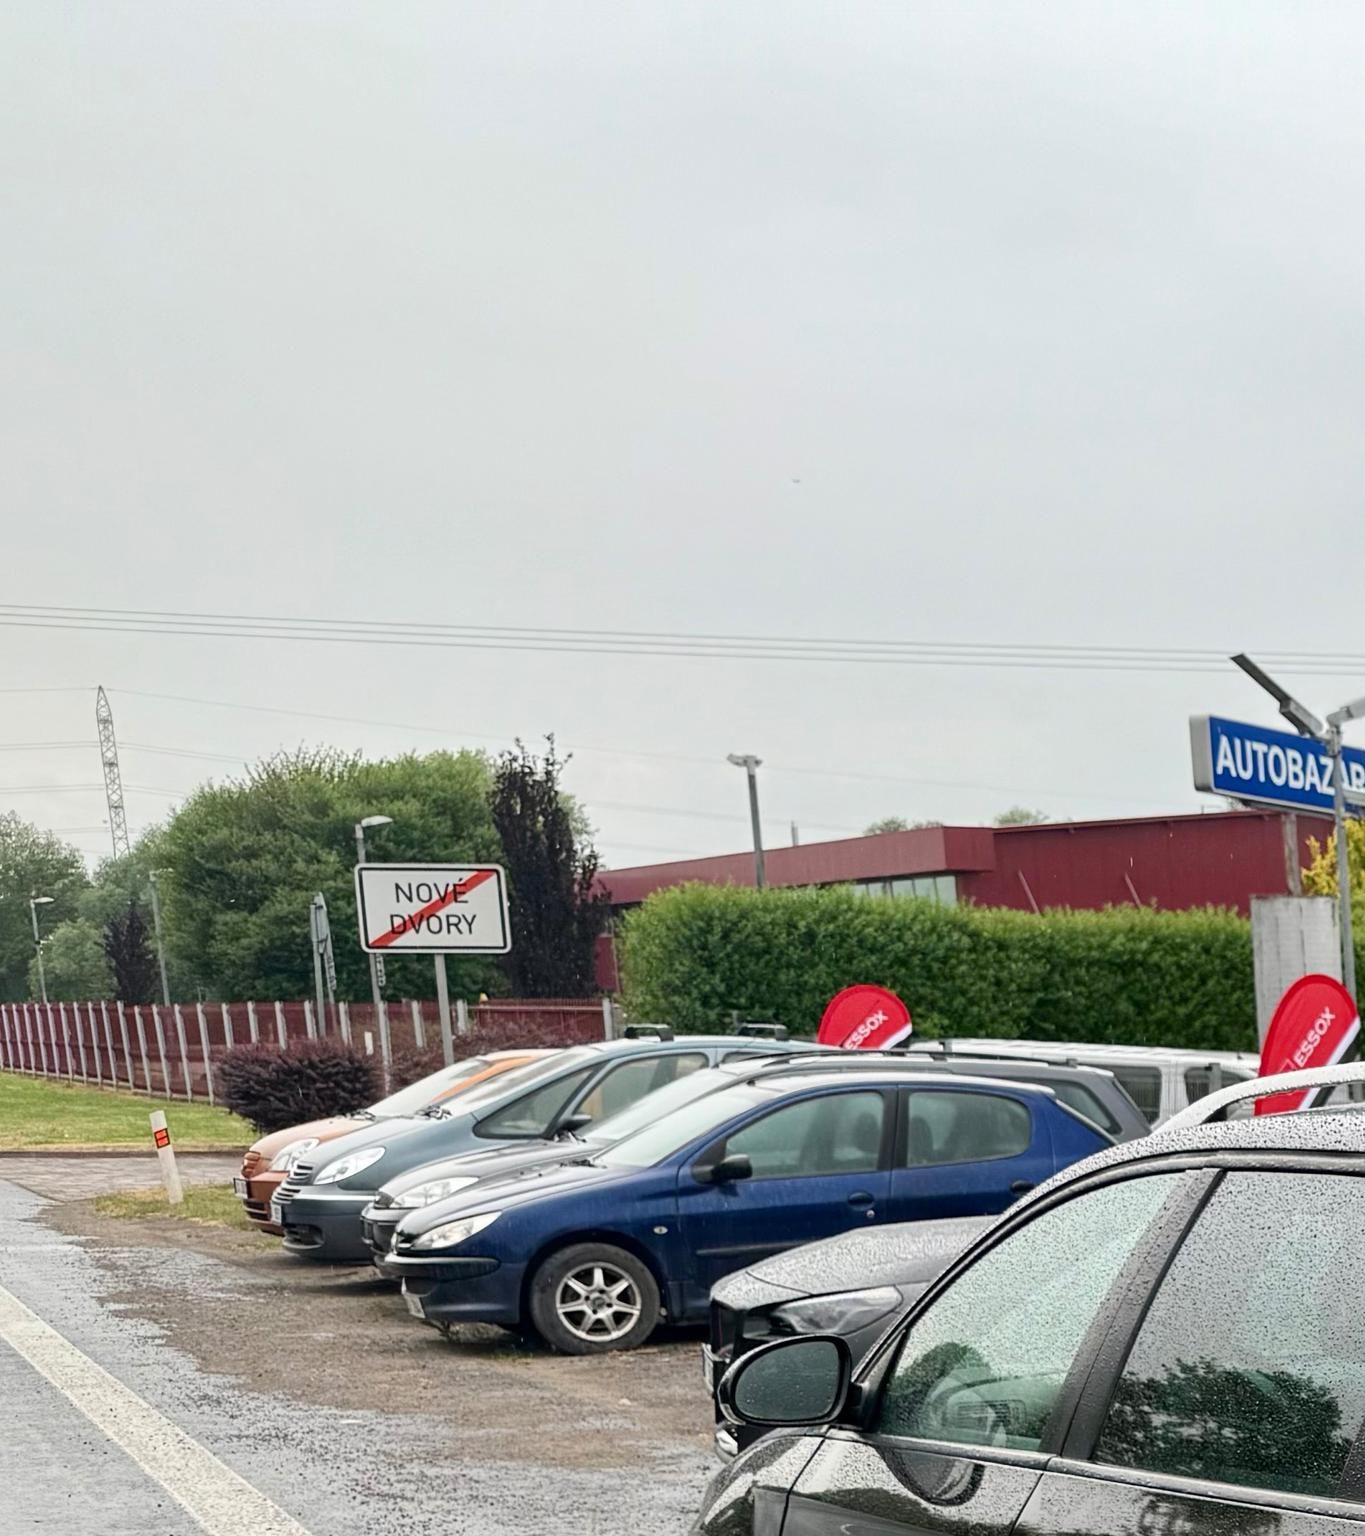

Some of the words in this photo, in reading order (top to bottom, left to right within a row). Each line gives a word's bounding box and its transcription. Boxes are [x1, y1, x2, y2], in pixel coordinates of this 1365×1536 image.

[394, 877, 469, 904] NOVÉ
[390, 914, 477, 936] DVORY
[1293, 1006, 1336, 1068] ESSOX
